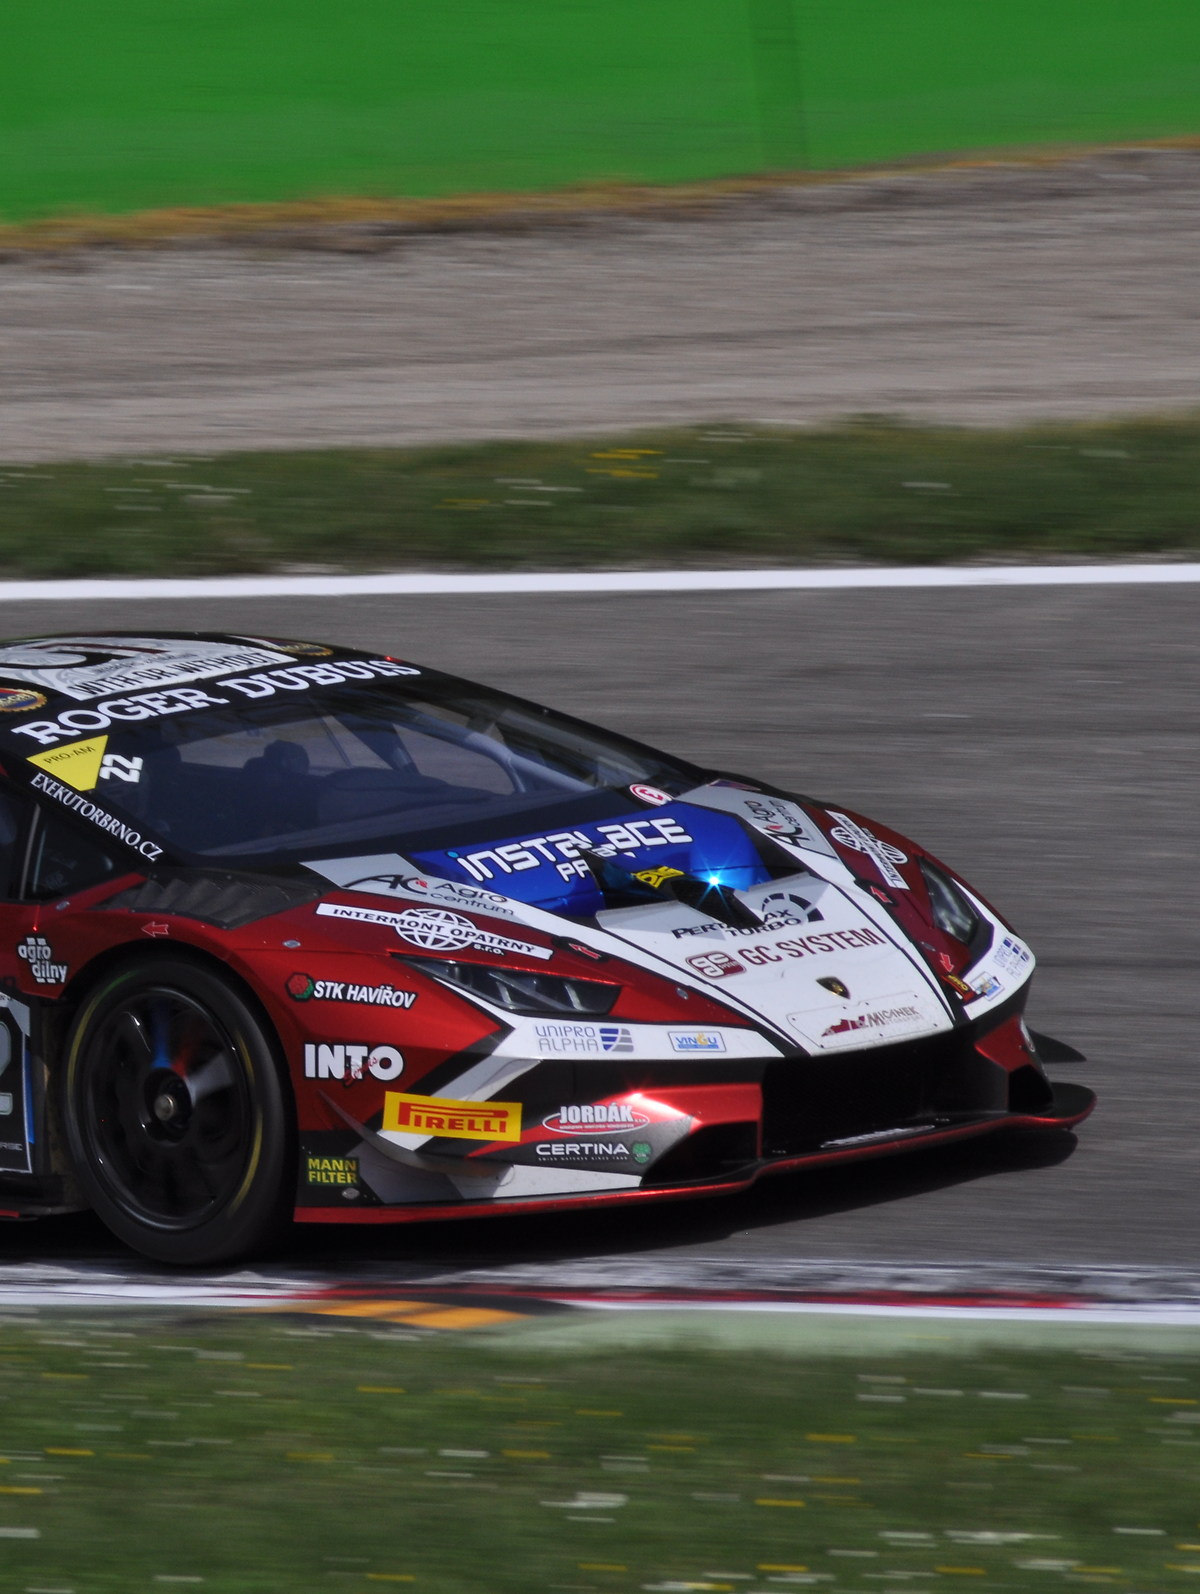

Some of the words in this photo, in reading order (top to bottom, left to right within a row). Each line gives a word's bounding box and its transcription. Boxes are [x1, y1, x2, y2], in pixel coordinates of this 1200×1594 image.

[11, 688, 230, 745] ROGER
[216, 659, 423, 700] DUBUIS
[42, 745, 97, 766] PRO-AM
[29, 771, 165, 862] EXEKUTORBRNO.CZ
[434, 881, 509, 903] Agro
[429, 892, 515, 916] centrum
[333, 907, 443, 933] INTERMONT
[18, 944, 51, 963] agro
[738, 944, 783, 966] GC
[786, 927, 887, 960] SYSTEM
[313, 980, 344, 1000] STK
[345, 983, 417, 1009] HAVÍŘOV
[535, 1025, 596, 1038] UNIPRO
[538, 1038, 599, 1051] ALPHA
[304, 1044, 405, 1081] INTO
[397, 1101, 510, 1134] PIRELLI
[559, 1102, 634, 1125] JORDÁK
[535, 1142, 630, 1156] CERTINA
[307, 1157, 358, 1172] MANN
[307, 1171, 358, 1185] FILTER
